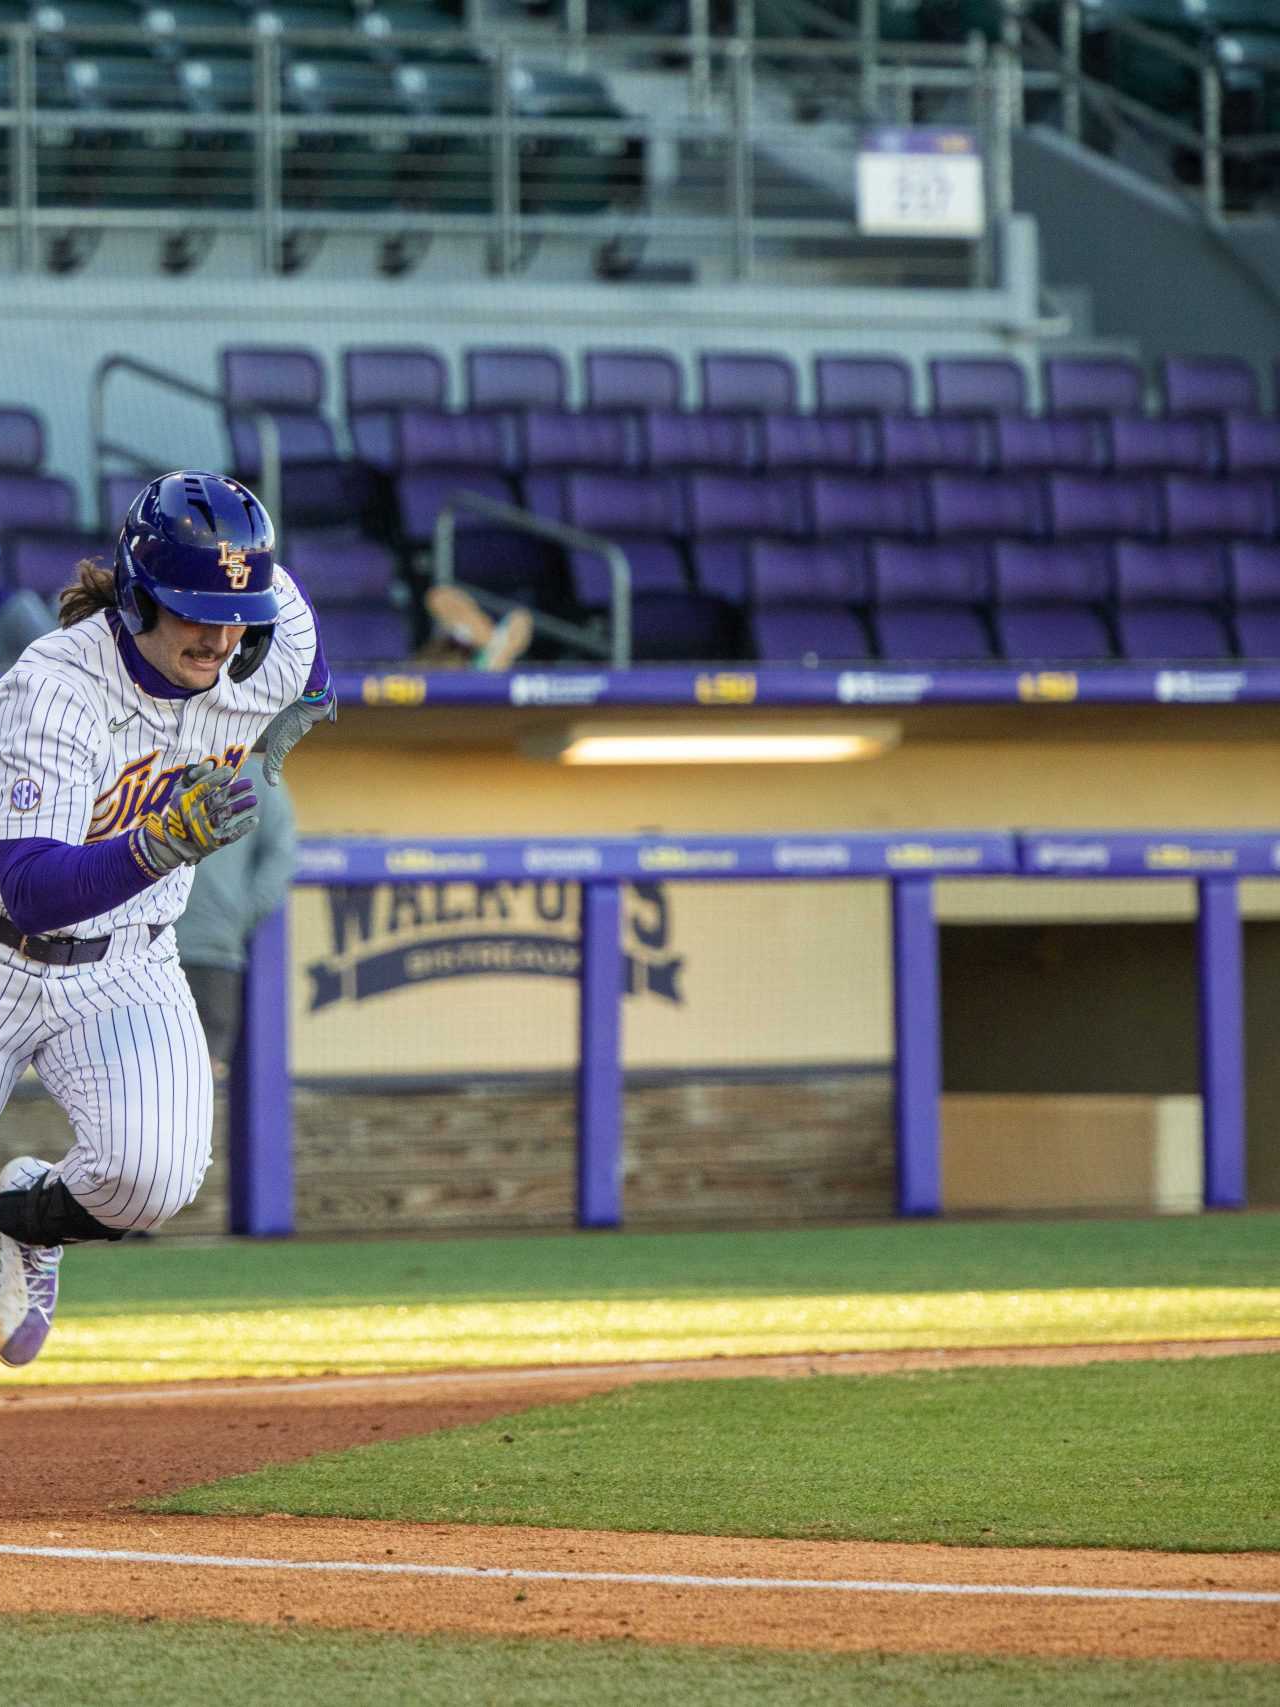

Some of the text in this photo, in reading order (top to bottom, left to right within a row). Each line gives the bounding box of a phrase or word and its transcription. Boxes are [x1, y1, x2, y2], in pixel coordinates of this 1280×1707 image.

[217, 541, 252, 590] LSU
[233, 612, 242, 622] 3
[12, 780, 40, 809] SEC
